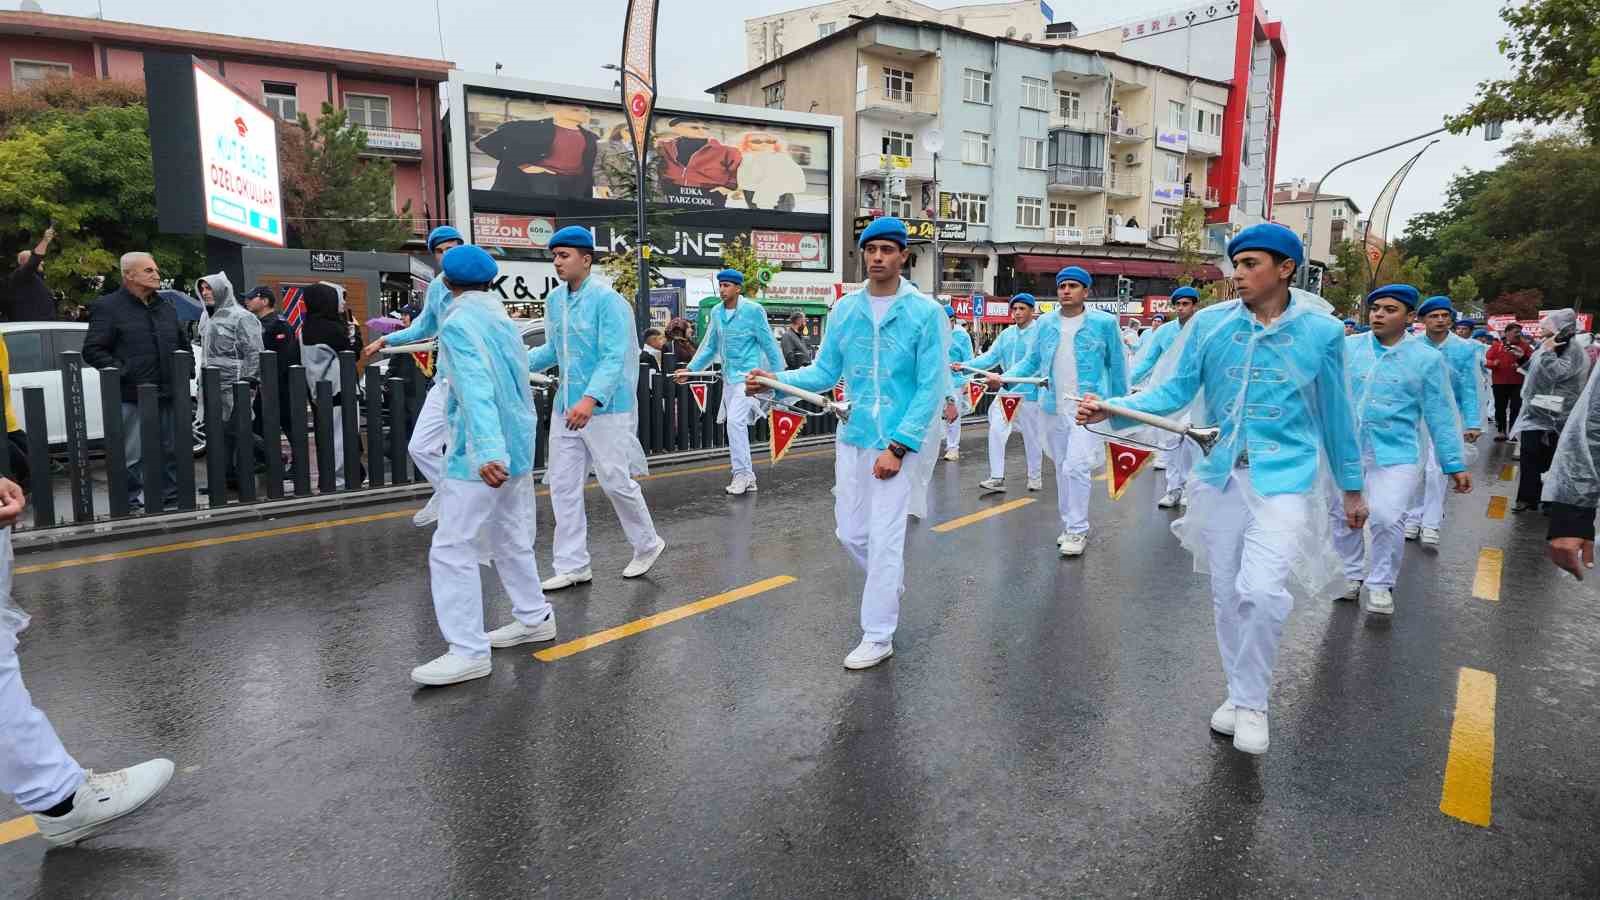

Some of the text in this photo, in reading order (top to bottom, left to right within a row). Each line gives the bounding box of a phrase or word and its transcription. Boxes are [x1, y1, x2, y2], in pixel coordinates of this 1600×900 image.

[474, 225, 522, 237] SEZON
[667, 231, 724, 257] JNS
[758, 241, 796, 252] SEZON
[513, 275, 537, 299] &
